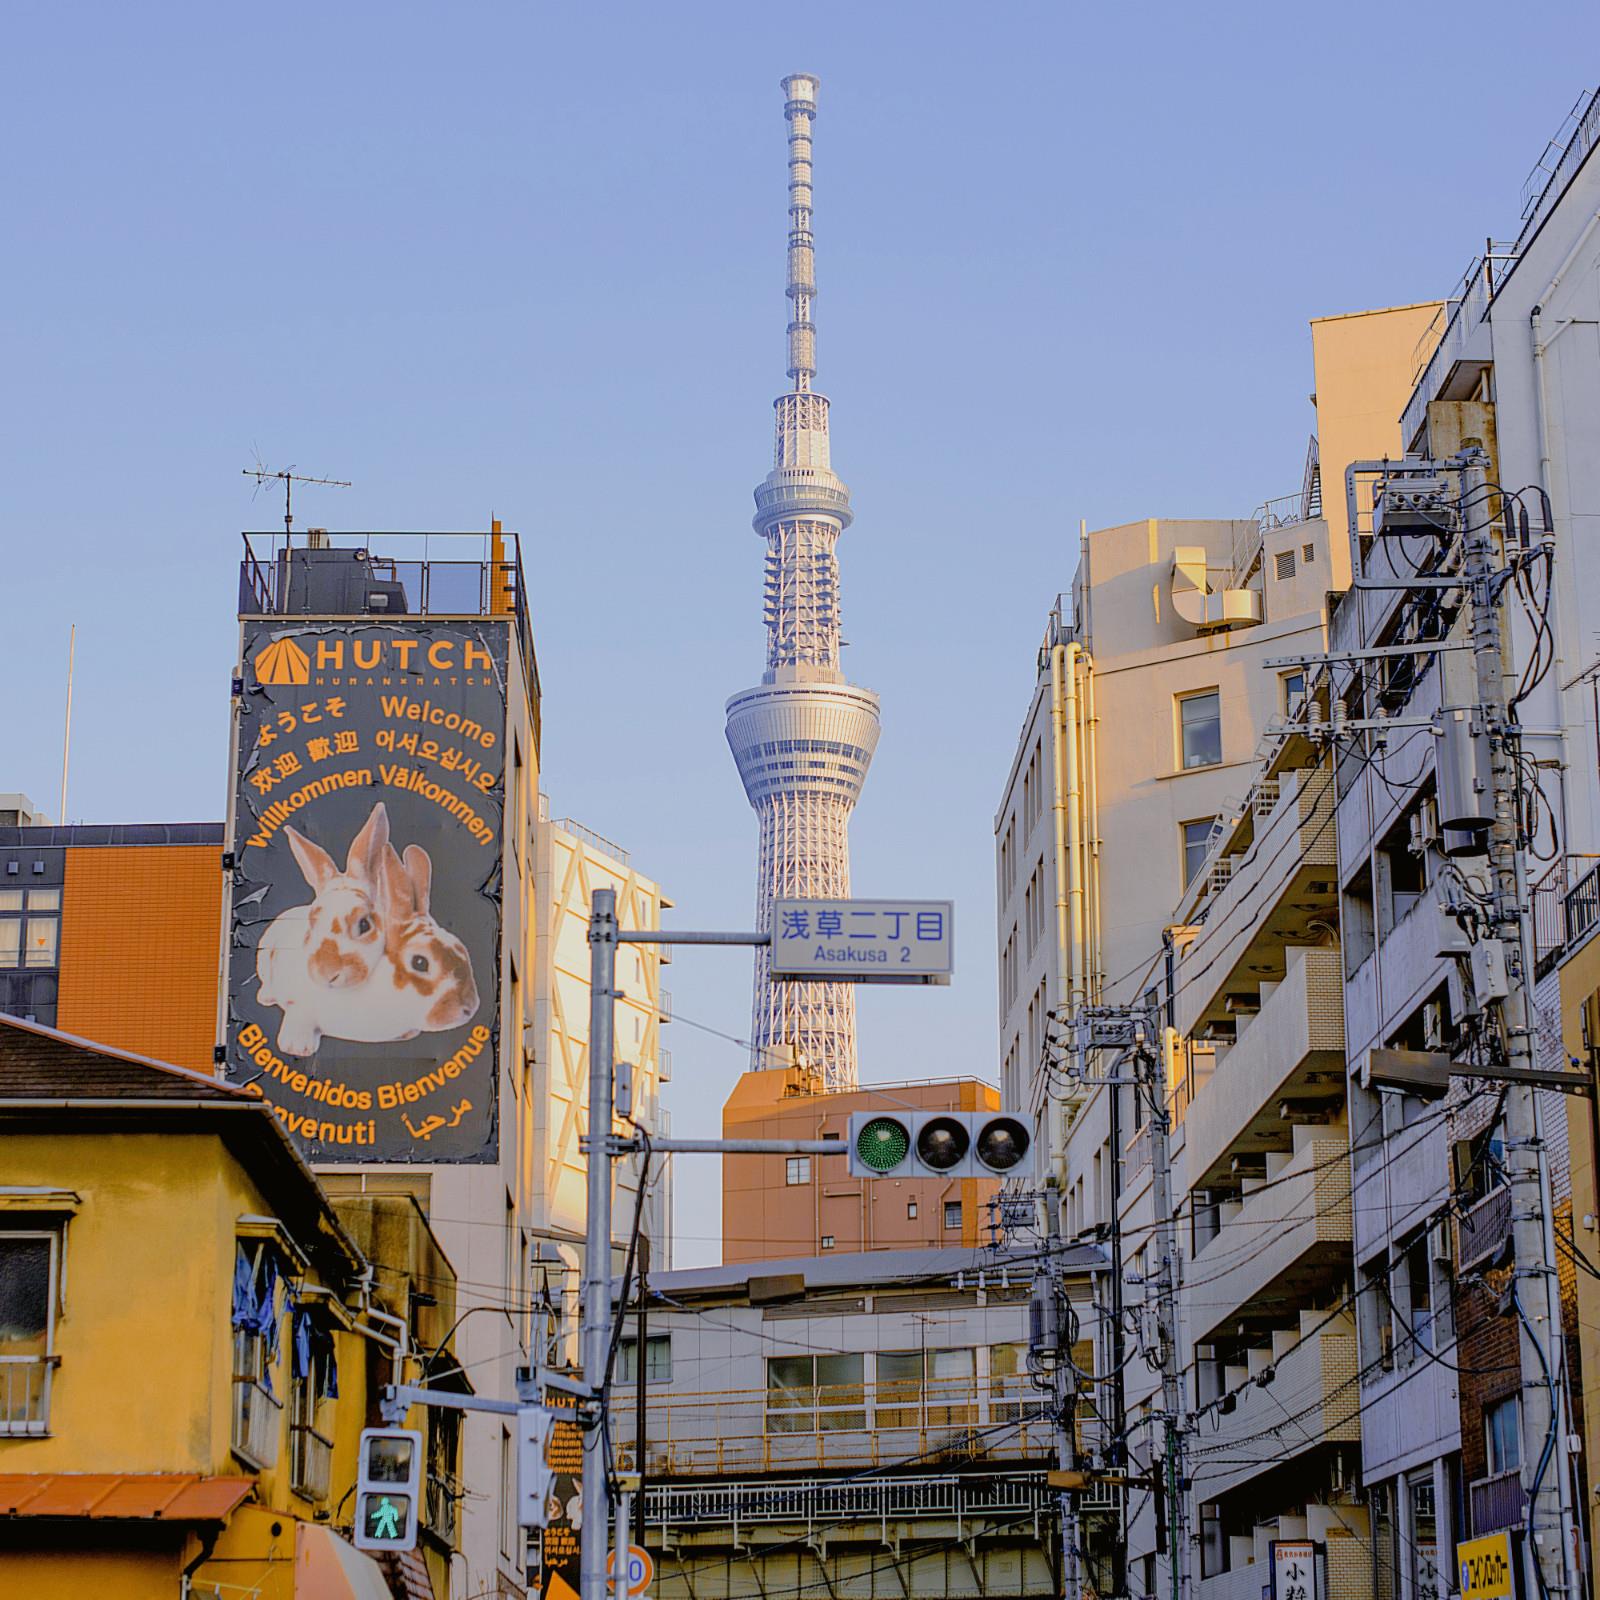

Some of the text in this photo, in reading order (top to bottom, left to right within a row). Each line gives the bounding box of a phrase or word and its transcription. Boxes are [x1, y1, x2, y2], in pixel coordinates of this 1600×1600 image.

[316, 640, 491, 670] HUTCH
[258, 696, 347, 747] ようこそ
[380, 695, 496, 748] Welcome
[375, 729, 496, 795] 어서오십시오
[245, 763, 496, 848] Willkommen Välkommen
[781, 909, 942, 941] 浅草二丁目
[814, 945, 911, 963] Asakusa 2
[238, 1023, 490, 1110] Bienvenidos Bienvenue
[242, 1082, 376, 1145] nvenuti
